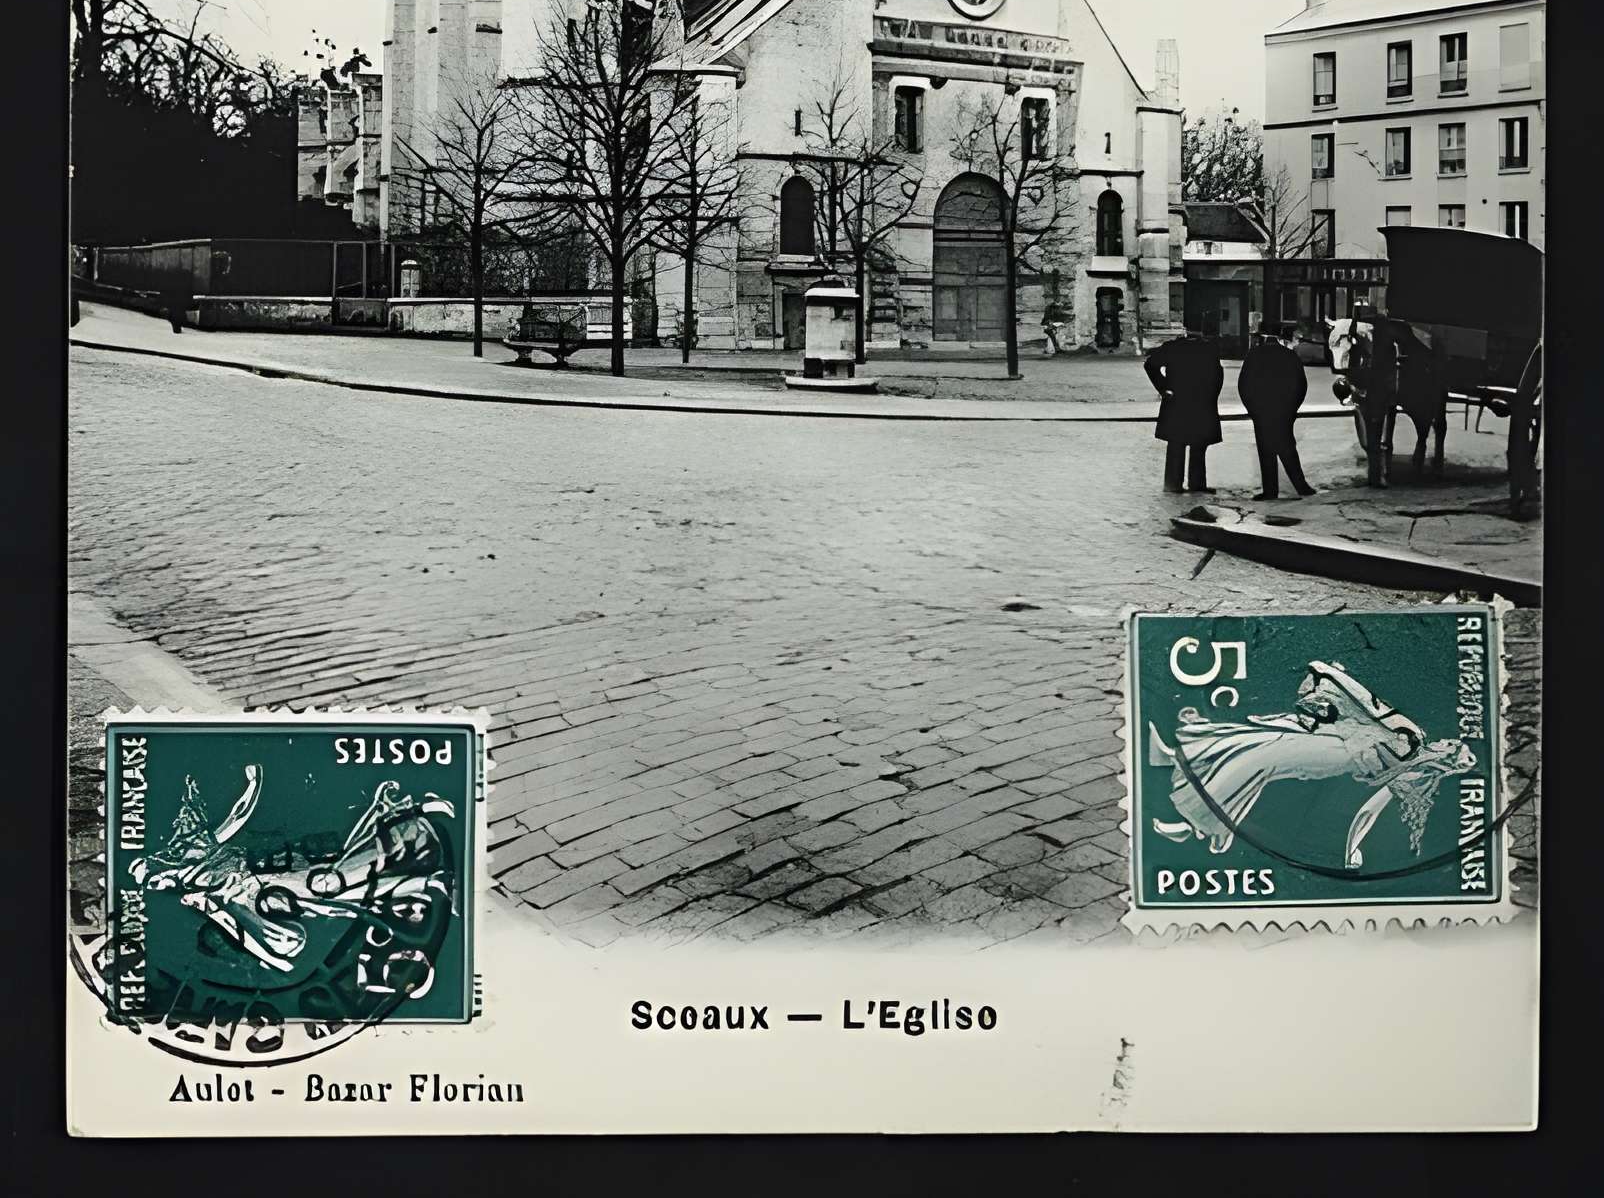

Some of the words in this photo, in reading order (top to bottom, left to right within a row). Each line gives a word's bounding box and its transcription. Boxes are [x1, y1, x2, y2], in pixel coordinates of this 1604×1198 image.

[335, 737, 453, 765] POSTES
[1156, 868, 1276, 896] POSTES
[409, 1073, 524, 1102] Florian
